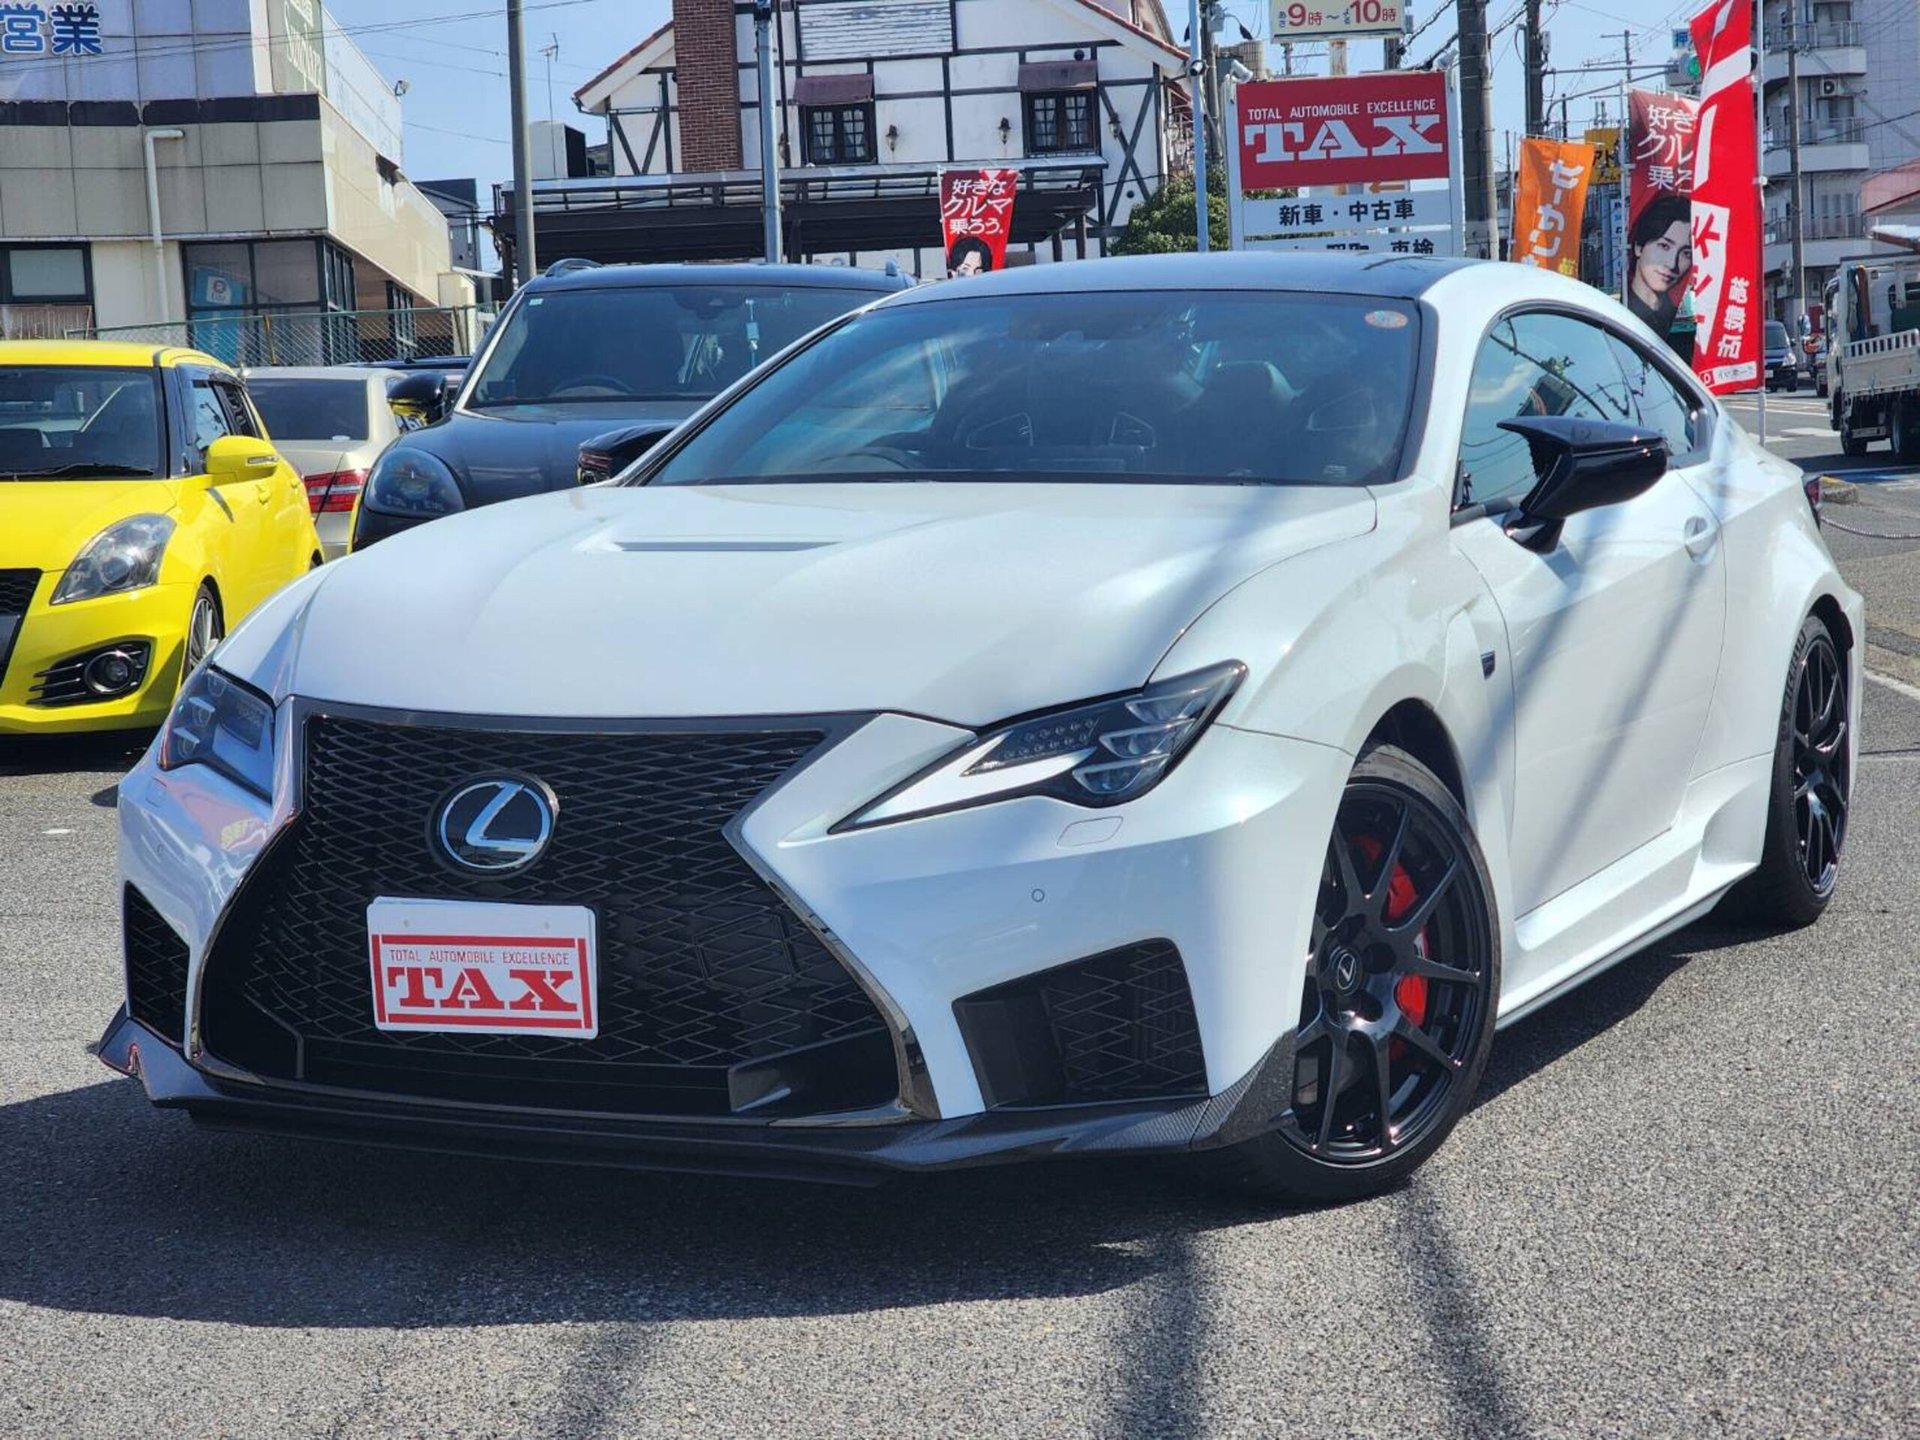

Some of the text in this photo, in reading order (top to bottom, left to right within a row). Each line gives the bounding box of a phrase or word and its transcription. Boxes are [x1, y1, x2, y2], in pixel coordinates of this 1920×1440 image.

[0, 3, 103, 55] 営業
[1247, 98, 1437, 121] TOTAL AUTOMOBILE EXCELLENCE
[1647, 104, 1697, 133] 好き
[1244, 114, 1443, 163] TAX
[1636, 128, 1695, 164] クル
[951, 178, 1007, 196] 好きな
[943, 195, 1013, 217] クルマ
[1278, 198, 1415, 227] 新車・中古車
[389, 949, 569, 965] TOTAL AUTOMOBILE EXCELLENCE
[387, 966, 578, 1012] TAX
